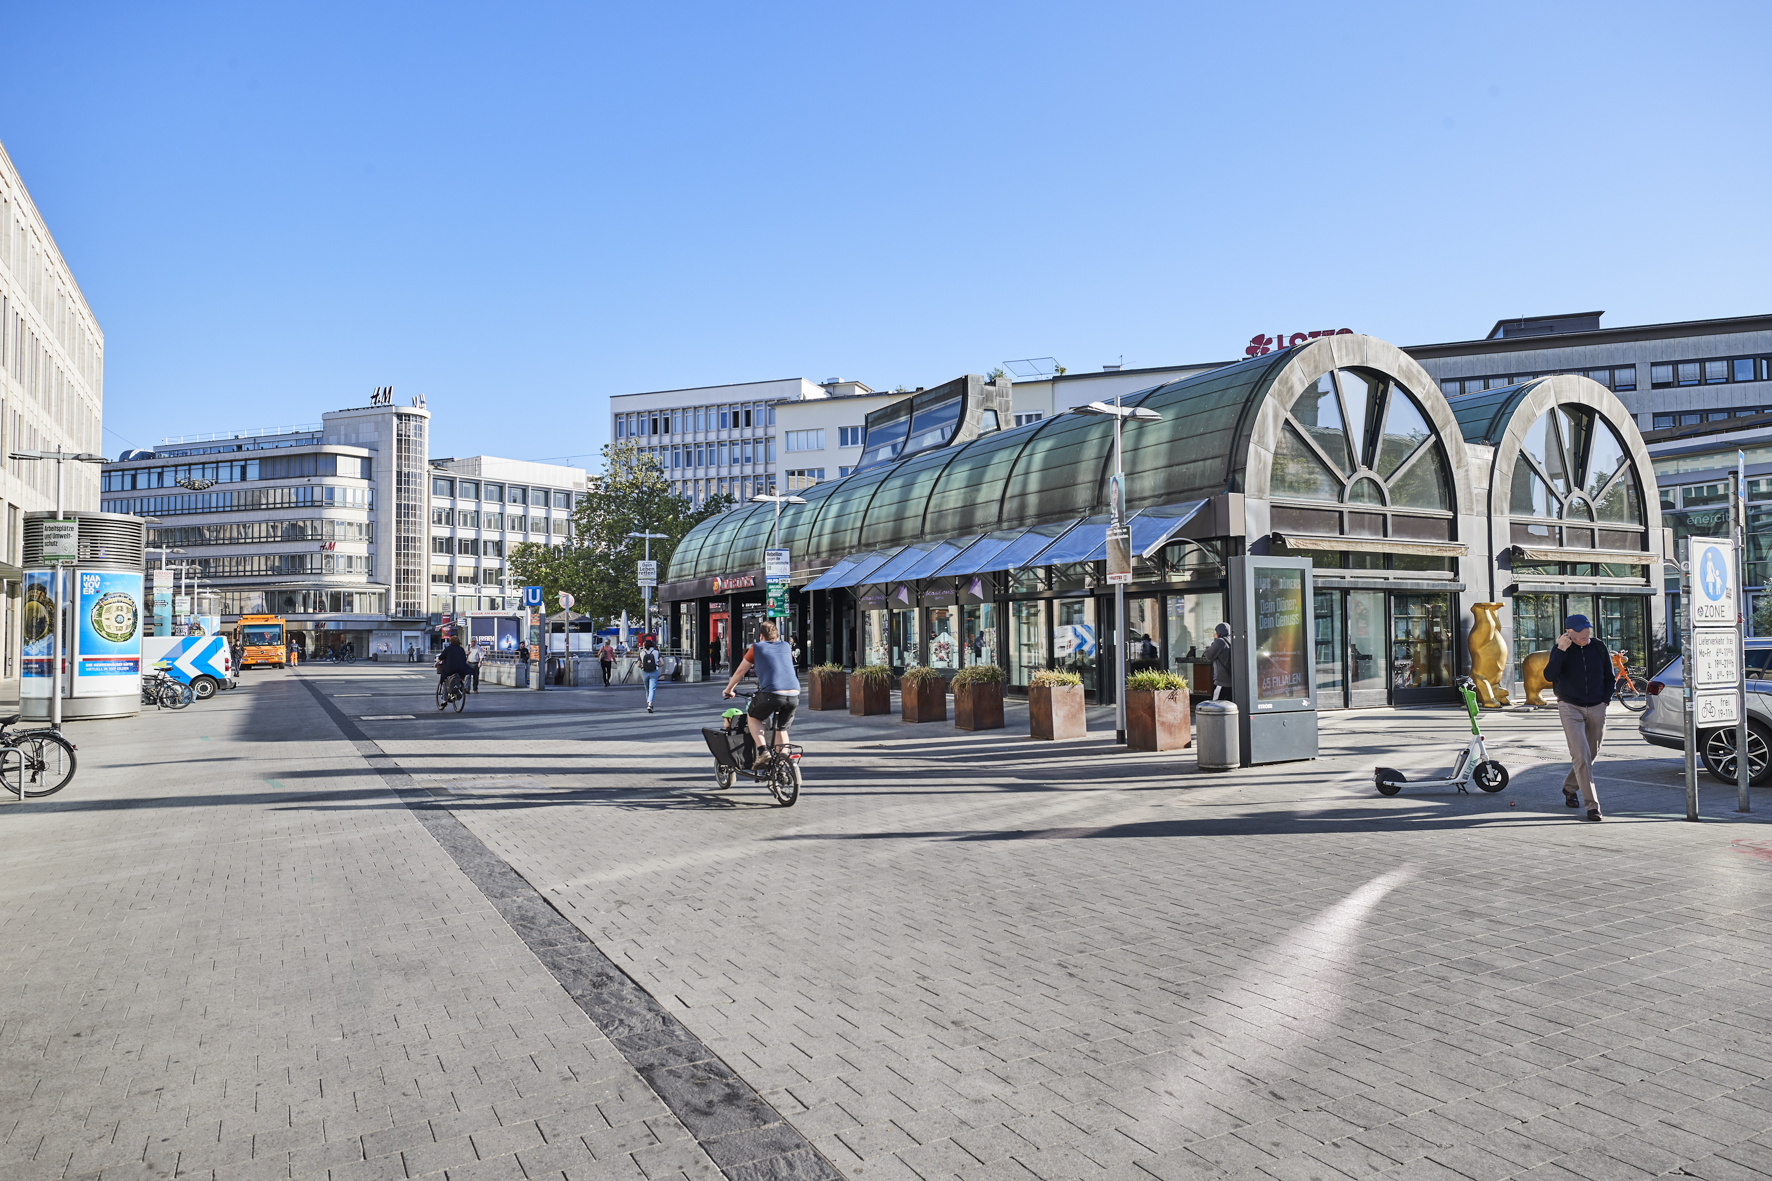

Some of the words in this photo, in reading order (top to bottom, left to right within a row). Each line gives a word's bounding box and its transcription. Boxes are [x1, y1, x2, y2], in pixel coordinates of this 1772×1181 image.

[370, 385, 393, 407] H&M
[1687, 512, 1730, 525] enercit
[320, 541, 336, 551] H&M
[83, 574, 100, 582] HAN
[528, 588, 541, 604] U
[1260, 599, 1275, 614] Dein
[1276, 597, 1298, 612] Döner,
[1704, 604, 1725, 618] ZONE
[1259, 614, 1275, 629] Dein
[1275, 613, 1300, 628] Genuss
[1699, 636, 1724, 645] Lieferverkehr
[1262, 677, 1271, 689] 65
[1272, 672, 1302, 688] FILIALEN
[1720, 697, 1730, 707] frei
[1464, 755, 1478, 775] Lime
